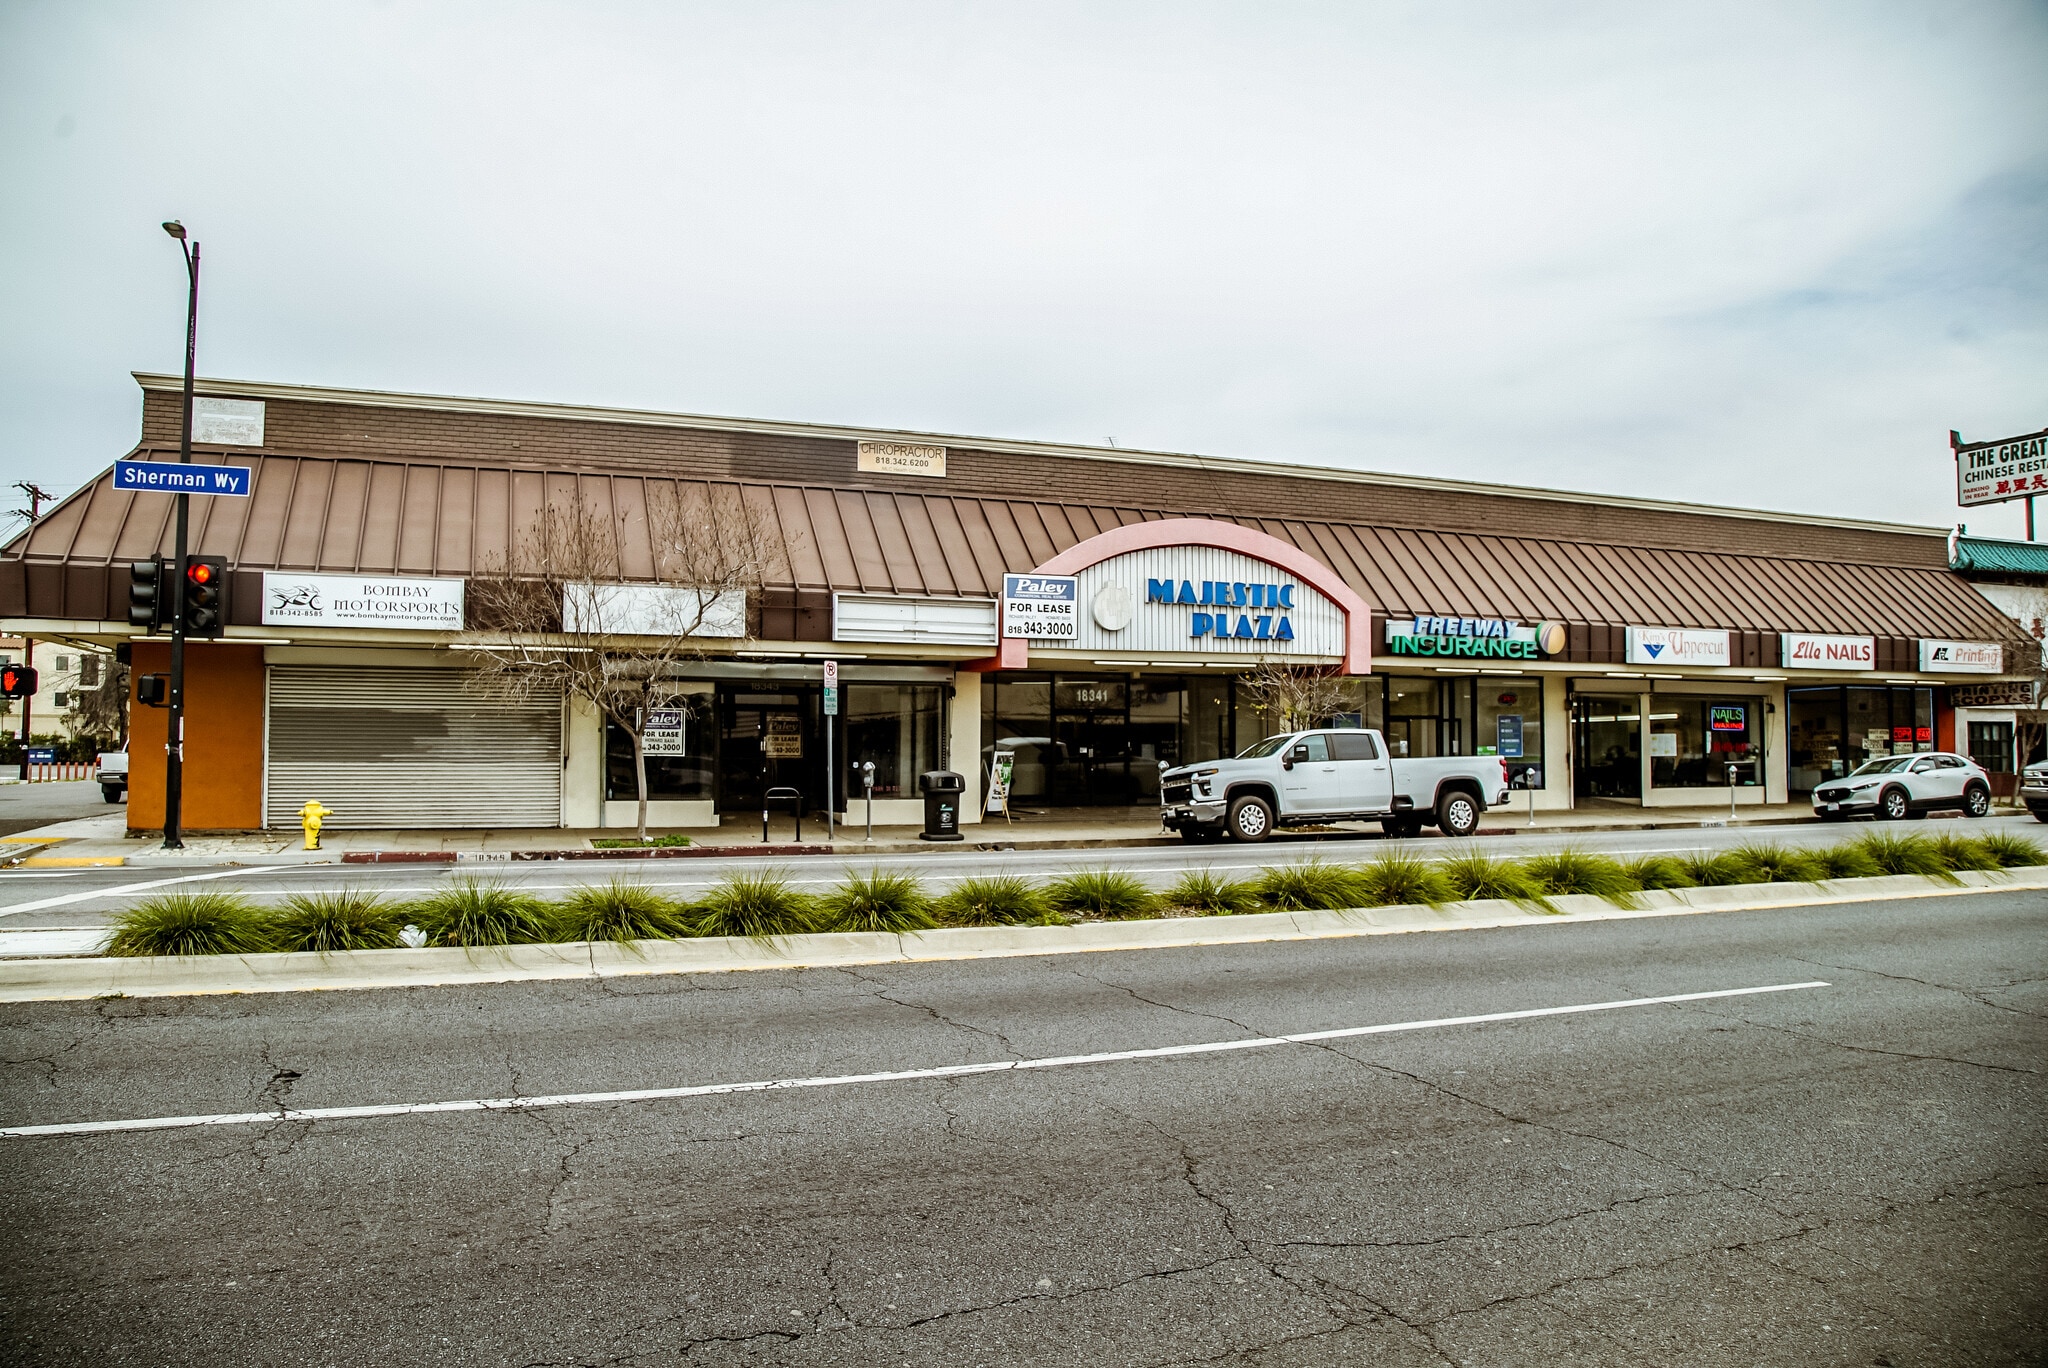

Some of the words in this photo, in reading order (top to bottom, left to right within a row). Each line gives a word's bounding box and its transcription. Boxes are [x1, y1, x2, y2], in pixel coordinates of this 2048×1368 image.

[860, 443, 943, 459] CHIROPRACTOR
[1967, 448, 1995, 469] THE
[1999, 437, 2048, 463] GREAT
[875, 457, 929, 467] 818.342.6200
[1964, 464, 2015, 483] CHINESE
[2018, 458, 2048, 474] REST
[124, 467, 206, 487] Sherman
[214, 473, 240, 492] Wy
[1962, 485, 1990, 495] PARKING
[1973, 491, 1989, 499] REAR
[363, 584, 432, 598] BOMBAY
[1016, 579, 1067, 594] Paley
[1146, 578, 1295, 609] MAJESTIC
[269, 609, 323, 617] 818-342-8585
[333, 598, 460, 615] MOTORSPORTS
[1010, 603, 1032, 612] FOR
[1037, 604, 1071, 613] LEASE
[336, 612, 458, 622] www.bombaymotorsports.com
[1007, 625, 1023, 634] 818
[1024, 622, 1073, 635] 343-3000
[1191, 612, 1295, 640] PLAZA
[1413, 616, 1519, 638] FREEWAY
[1391, 635, 1538, 659] INSURANCE
[1668, 631, 1724, 658] Uppercut
[1792, 641, 1821, 659] Elle
[1826, 643, 1871, 661] NAILS
[1955, 647, 1998, 665] Printing
[1076, 689, 1108, 702] 18341
[1951, 684, 2031, 697] PRINTING
[1712, 708, 1743, 721] NAILS
[1893, 730, 1911, 738] COPY
[1918, 730, 1931, 738] FAX
